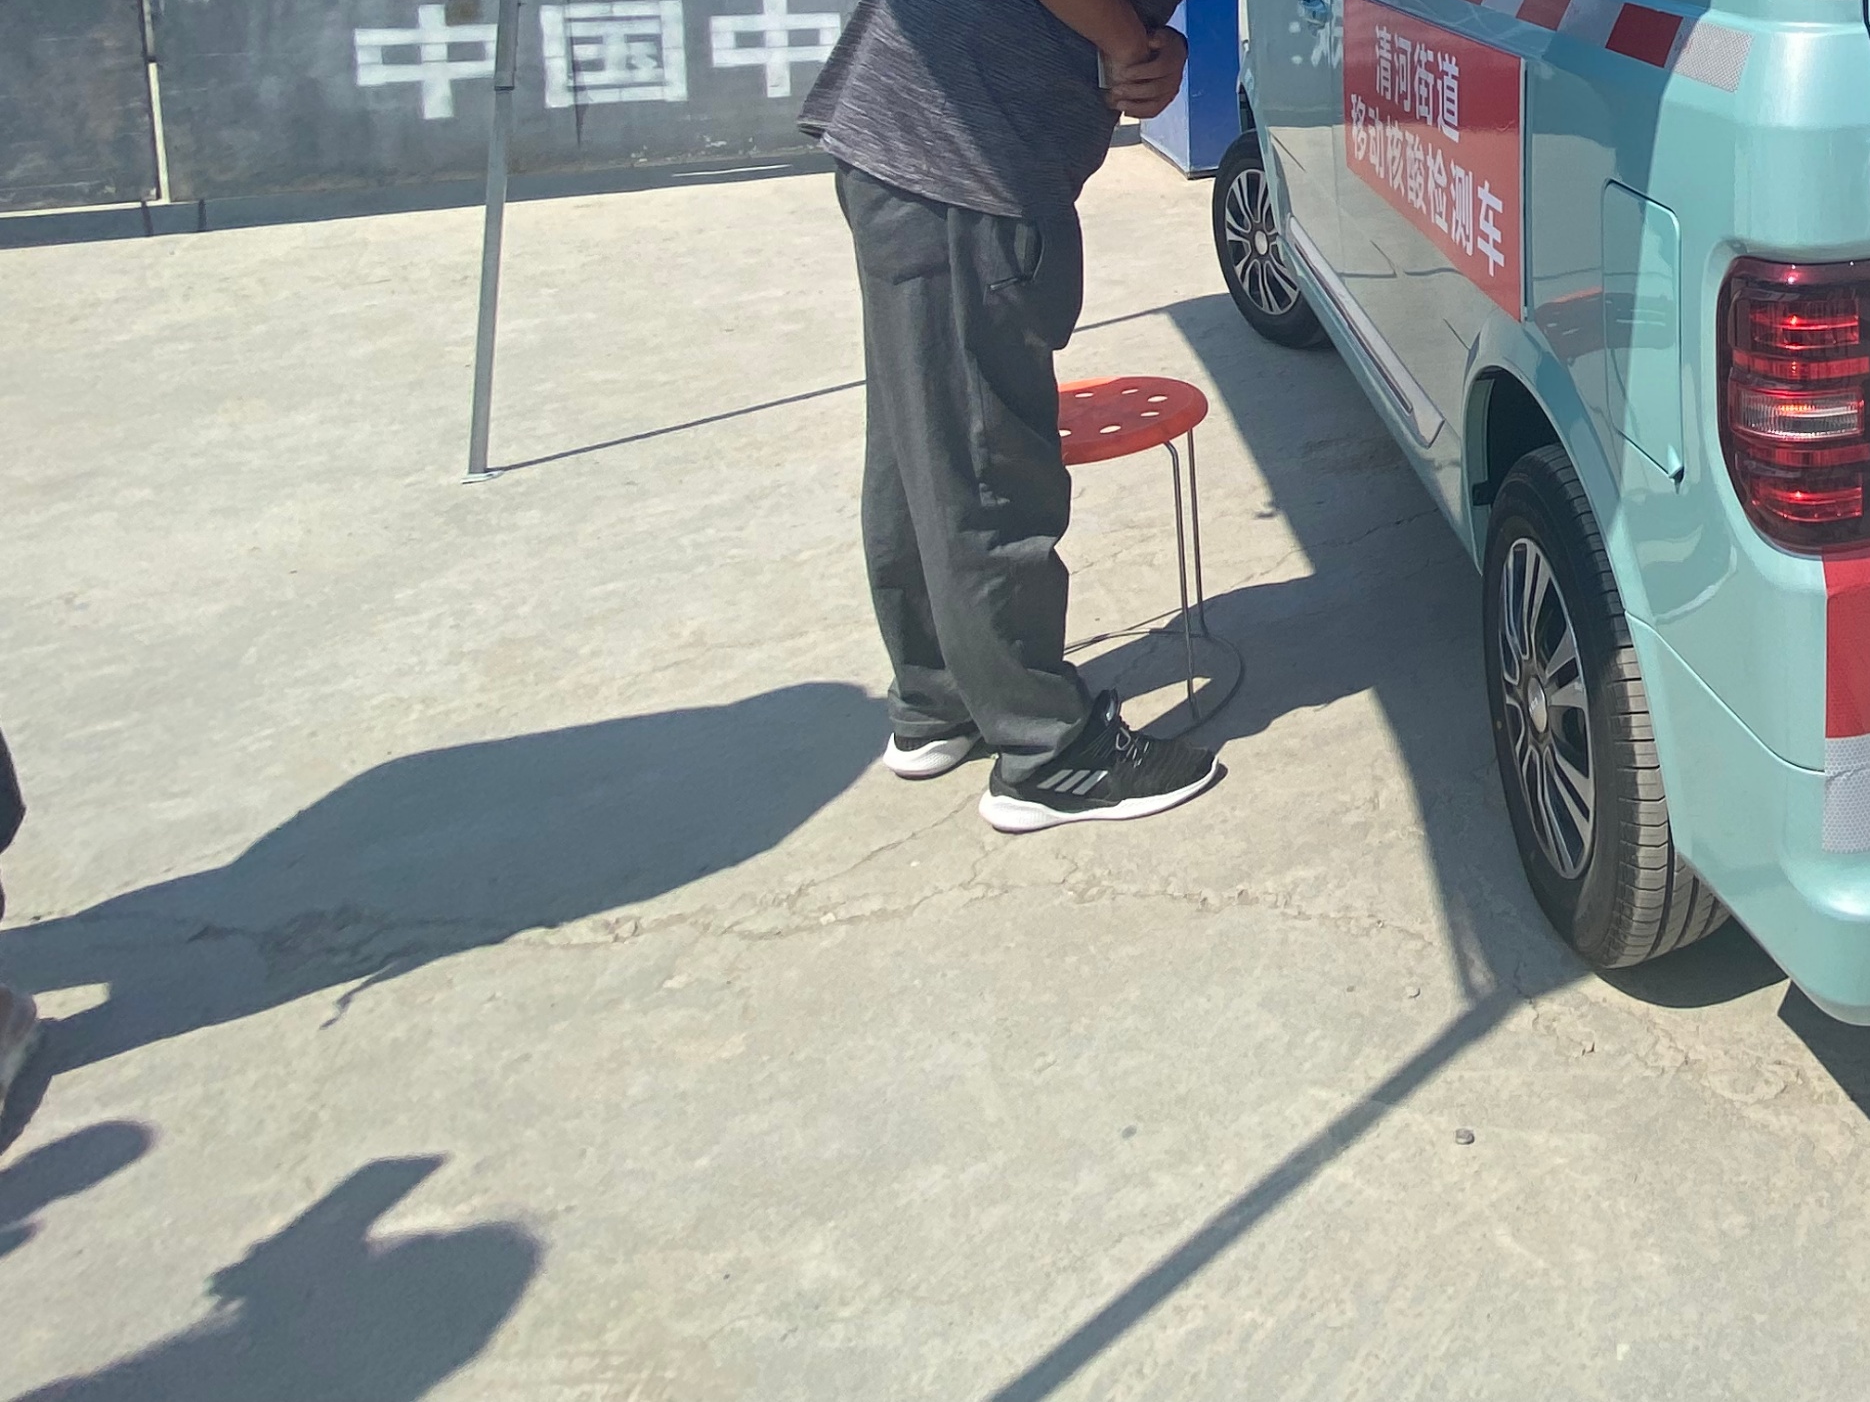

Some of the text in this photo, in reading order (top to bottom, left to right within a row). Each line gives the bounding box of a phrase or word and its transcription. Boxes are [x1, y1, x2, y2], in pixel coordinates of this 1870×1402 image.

[1375, 25, 1460, 143] 清河街道
[1351, 94, 1505, 278] 移动核酸检测车
